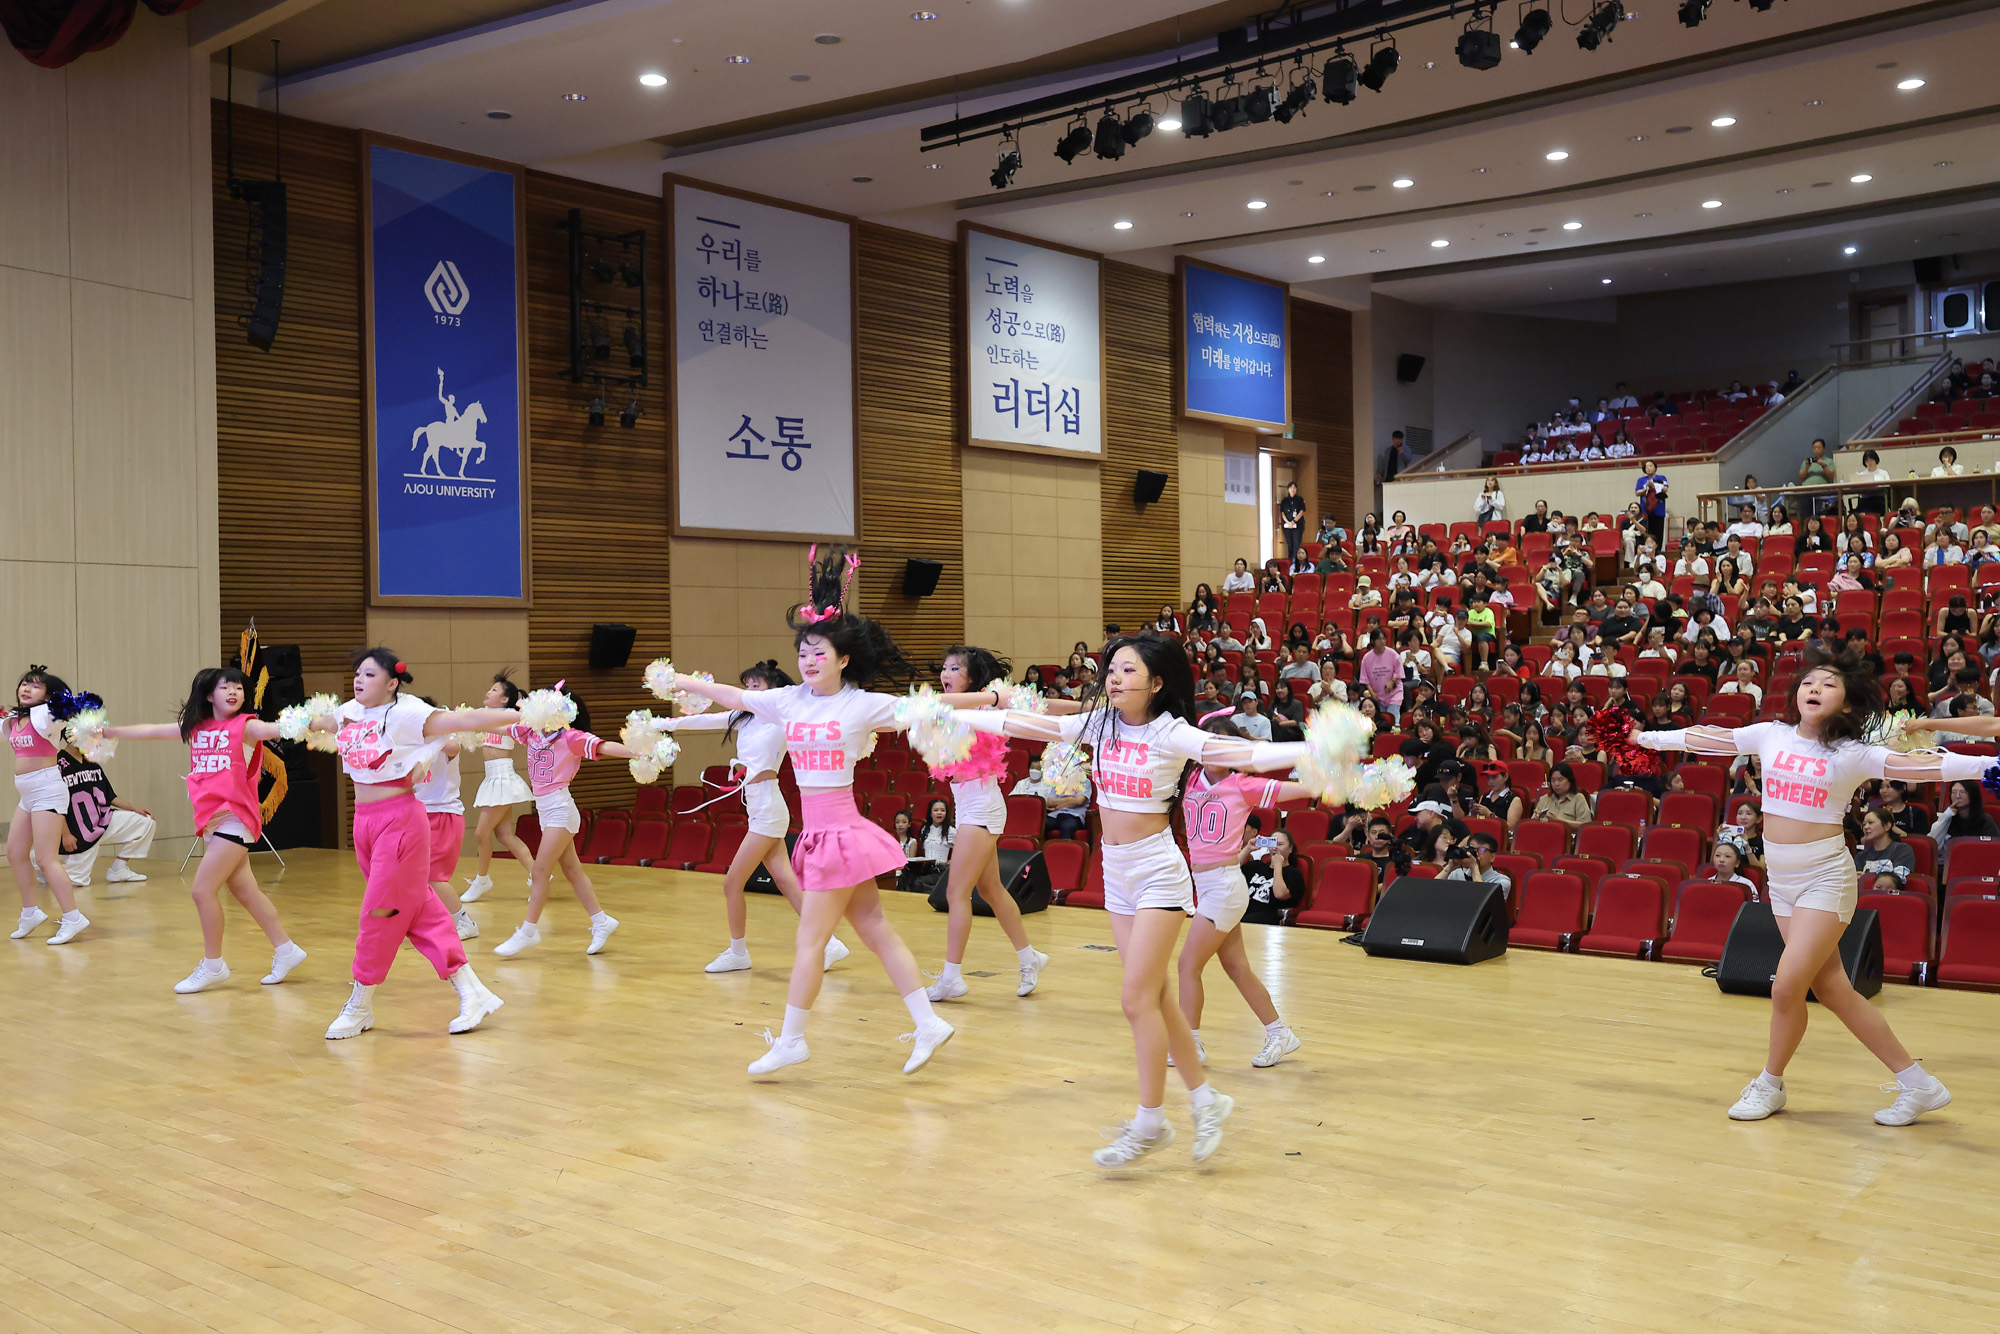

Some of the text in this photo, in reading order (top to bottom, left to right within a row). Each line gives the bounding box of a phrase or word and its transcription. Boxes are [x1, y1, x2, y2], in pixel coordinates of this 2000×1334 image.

[696, 233, 762, 272] 우리를
[697, 275, 788, 316] 하나로(路)
[985, 272, 1034, 304] 노력을
[434, 315, 461, 327] 1973
[698, 319, 769, 350] 연결하는
[986, 307, 1066, 344] 성공으로(路)
[1192, 312, 1231, 340] 협력하는
[986, 344, 1040, 370] 인도하는
[1201, 345, 1231, 371] 미래를
[992, 377, 1080, 435] 리더십
[726, 414, 812, 472] 소통
[403, 483, 496, 499] AJOU UNIVERSITY
[1772, 750, 1828, 777] LET'S
[1093, 770, 1153, 798] CHEER
[1766, 777, 1829, 809] CHEER
